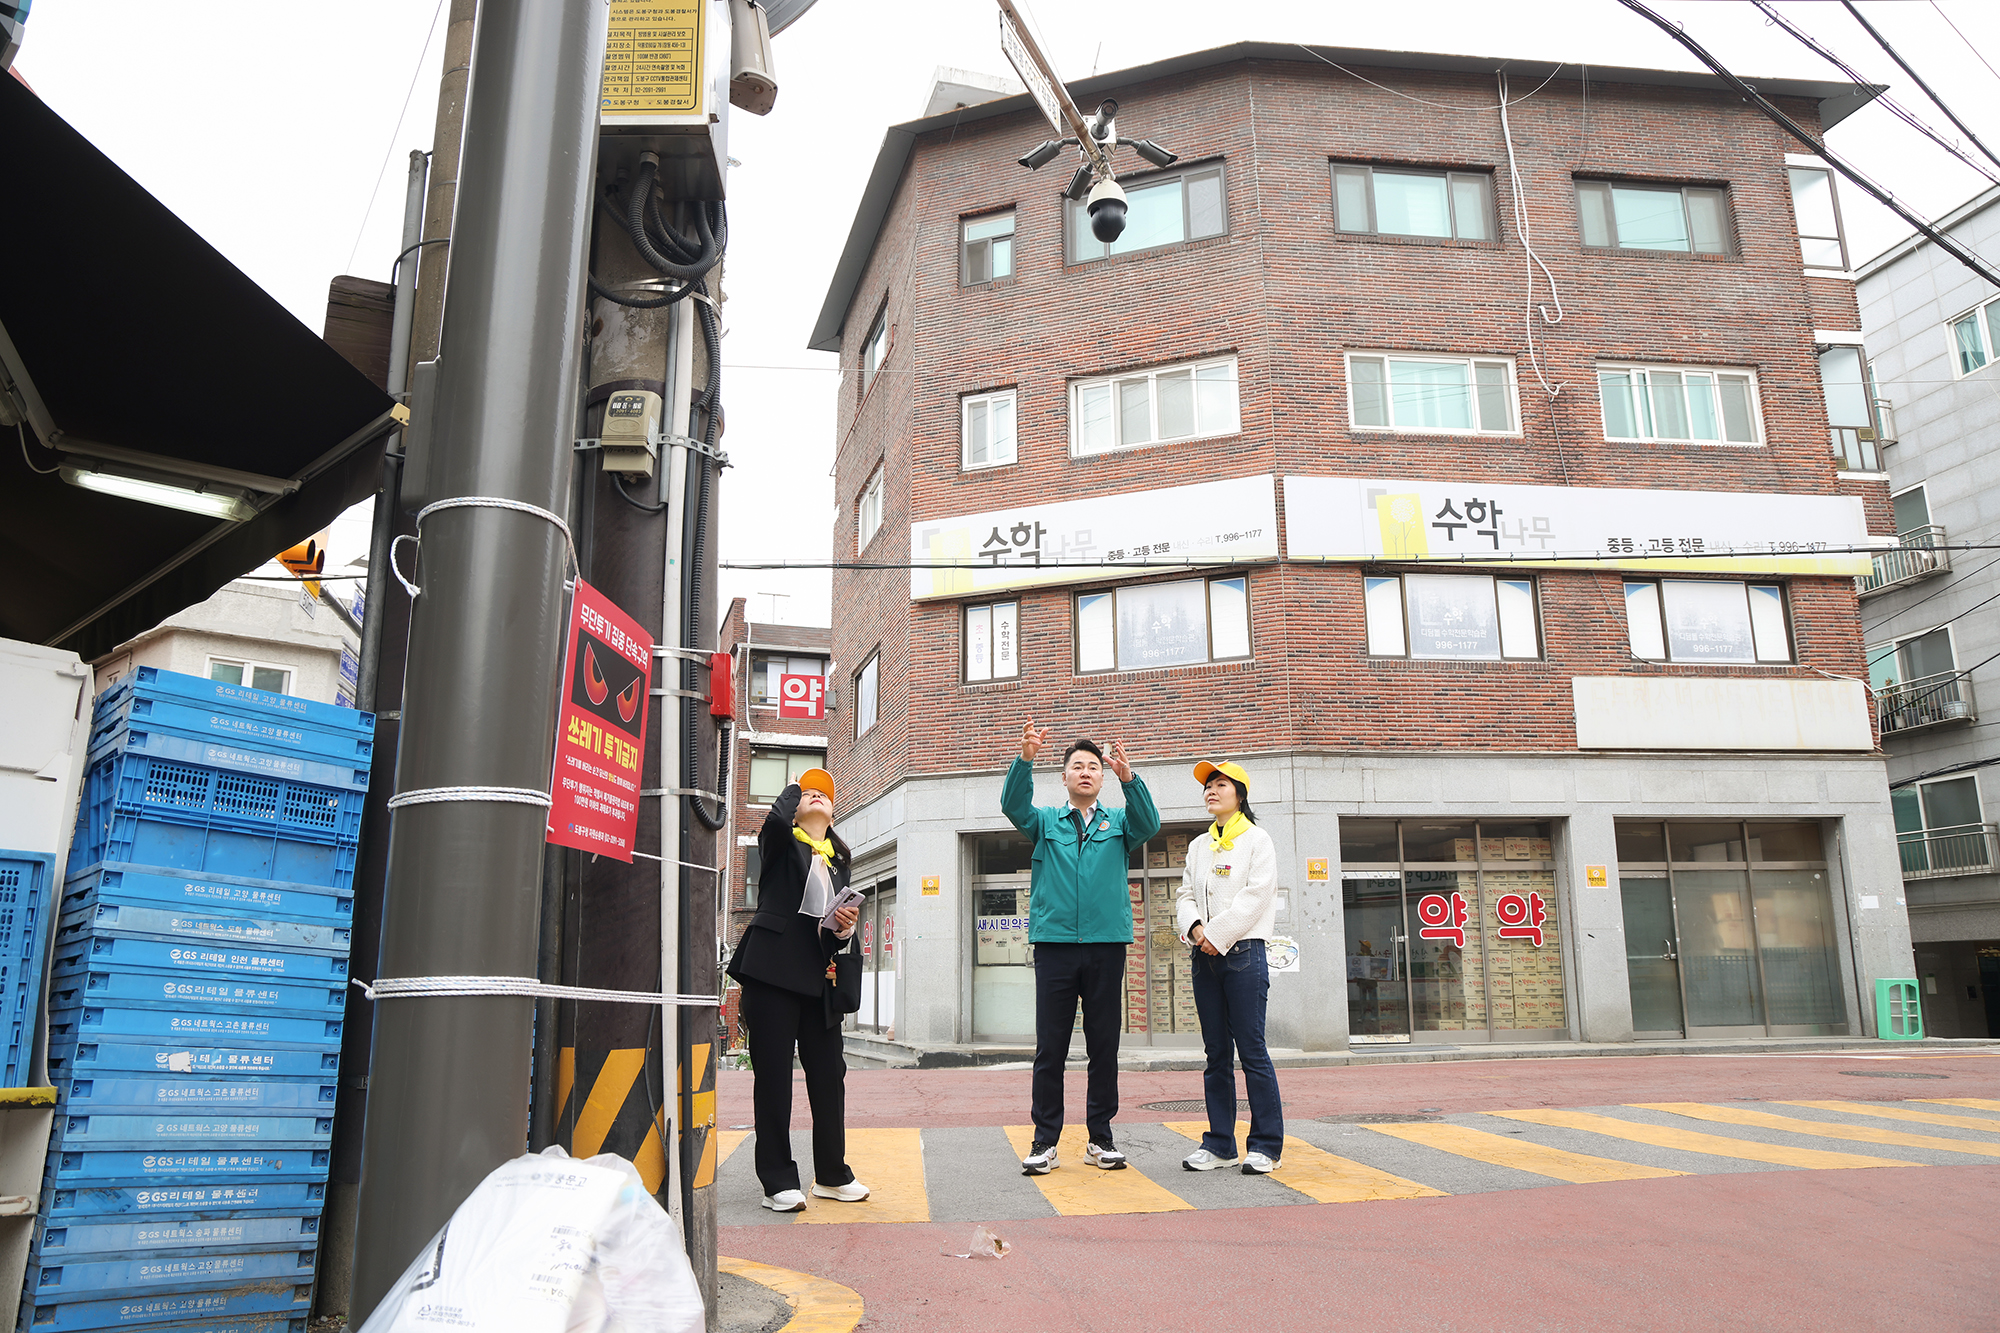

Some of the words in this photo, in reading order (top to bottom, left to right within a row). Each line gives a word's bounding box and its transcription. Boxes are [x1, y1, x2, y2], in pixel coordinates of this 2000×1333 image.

[1107, 549, 1125, 561] 중등
[1132, 545, 1150, 556] 고등
[1152, 542, 1170, 554] 전문
[1215, 529, 1262, 544] T.996-1177
[1607, 538, 1634, 554] 중등
[1648, 538, 1674, 553] 고등
[1679, 538, 1704, 553] 전문
[1443, 607, 1463, 625] 수학
[1152, 614, 1172, 634] 수학
[581, 603, 612, 640] 무단투기
[611, 625, 625, 651] 집중
[625, 636, 648, 669] 단속구역
[1001, 621, 1010, 660] 수학전문
[1142, 646, 1185, 658] 996-1177
[1435, 641, 1478, 649] 996-1177
[238, 690, 259, 700] 리테일
[262, 695, 276, 704] 고양
[280, 698, 307, 710] 물류센터
[784, 678, 822, 716] 약
[261, 726, 274, 735] 고양
[276, 729, 302, 740] 물류센터
[567, 715, 602, 754] 쓰레기
[604, 732, 638, 772] 투기금지
[259, 758, 272, 767] 고양
[273, 760, 300, 772] 물류센터
[562, 777, 578, 792] 무단투기
[574, 824, 588, 837] 도봉구청
[208, 887, 230, 896] 리테일
[234, 890, 249, 898] 고양
[252, 891, 281, 902] 물류센터
[1418, 892, 1468, 948] 약
[1496, 891, 1547, 947] 약
[246, 927, 273, 937] 물류센터
[884, 914, 894, 960] 약
[864, 919, 873, 962] 약
[183, 951, 197, 960] GS
[200, 953, 226, 963] 리테일
[231, 956, 248, 964] 인천
[251, 957, 284, 967] 물류센터
[234, 989, 278, 999] 물류센터
[241, 1022, 269, 1031] 물류센터
[228, 1055, 273, 1064] 물류센터
[230, 1088, 258, 1097] 물류센터
[212, 1124, 228, 1132] 고양
[230, 1124, 259, 1133] 물류센터
[217, 1156, 263, 1166] 물류센터
[211, 1189, 258, 1199] 물류센터
[196, 1228, 210, 1237] 송파
[213, 1227, 242, 1237] 물류센터
[198, 1261, 213, 1269] 고양
[214, 1258, 244, 1268] 물류센터
[180, 1300, 195, 1309] 고양
[197, 1297, 227, 1308] 물류센터
